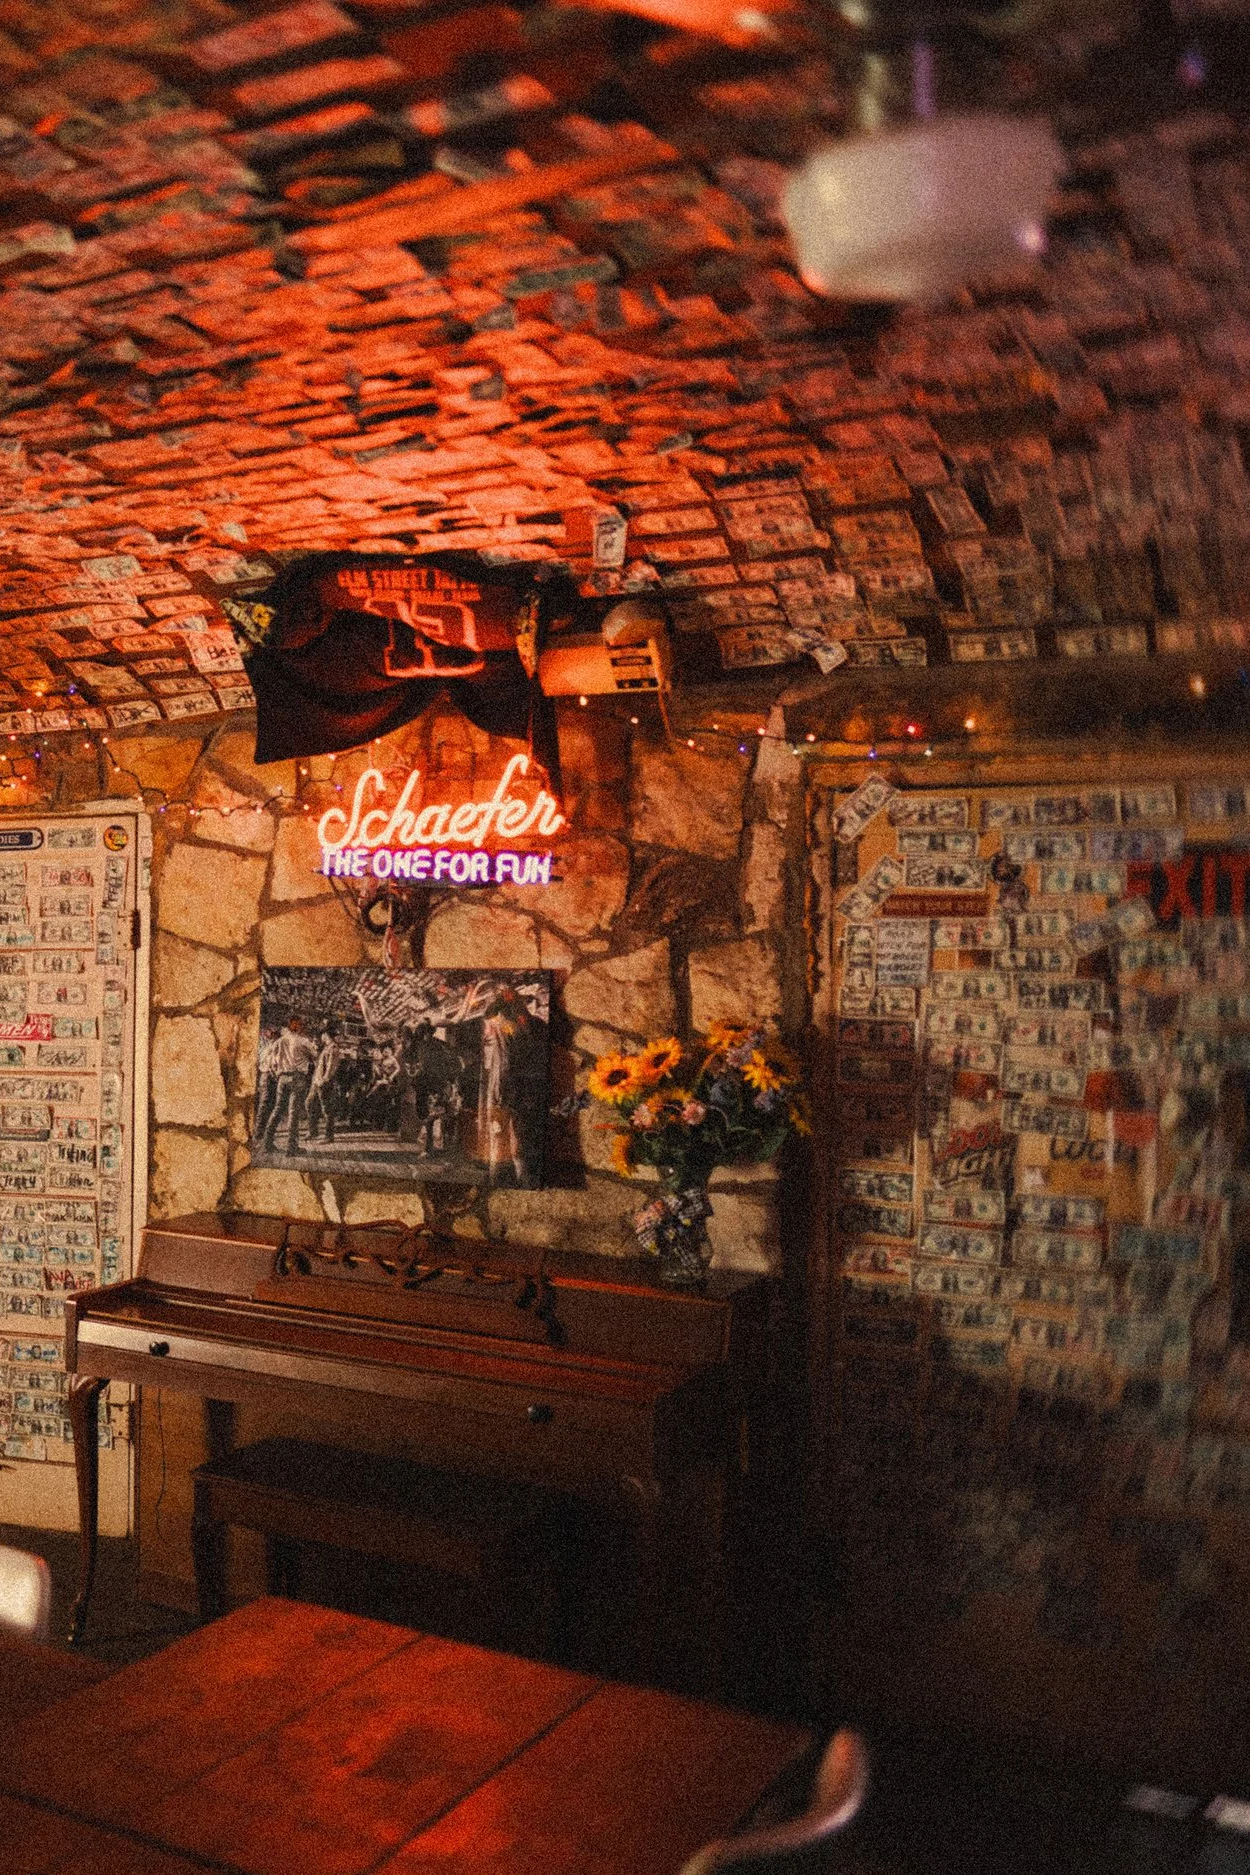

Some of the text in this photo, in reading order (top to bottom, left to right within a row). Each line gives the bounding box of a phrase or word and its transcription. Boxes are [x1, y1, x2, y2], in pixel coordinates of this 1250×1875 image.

[371, 569, 428, 588] STREET
[317, 753, 566, 849] Schaefer
[322, 849, 551, 885] THE ONE FOR FUN
[1122, 852, 1250, 921] EXIT
